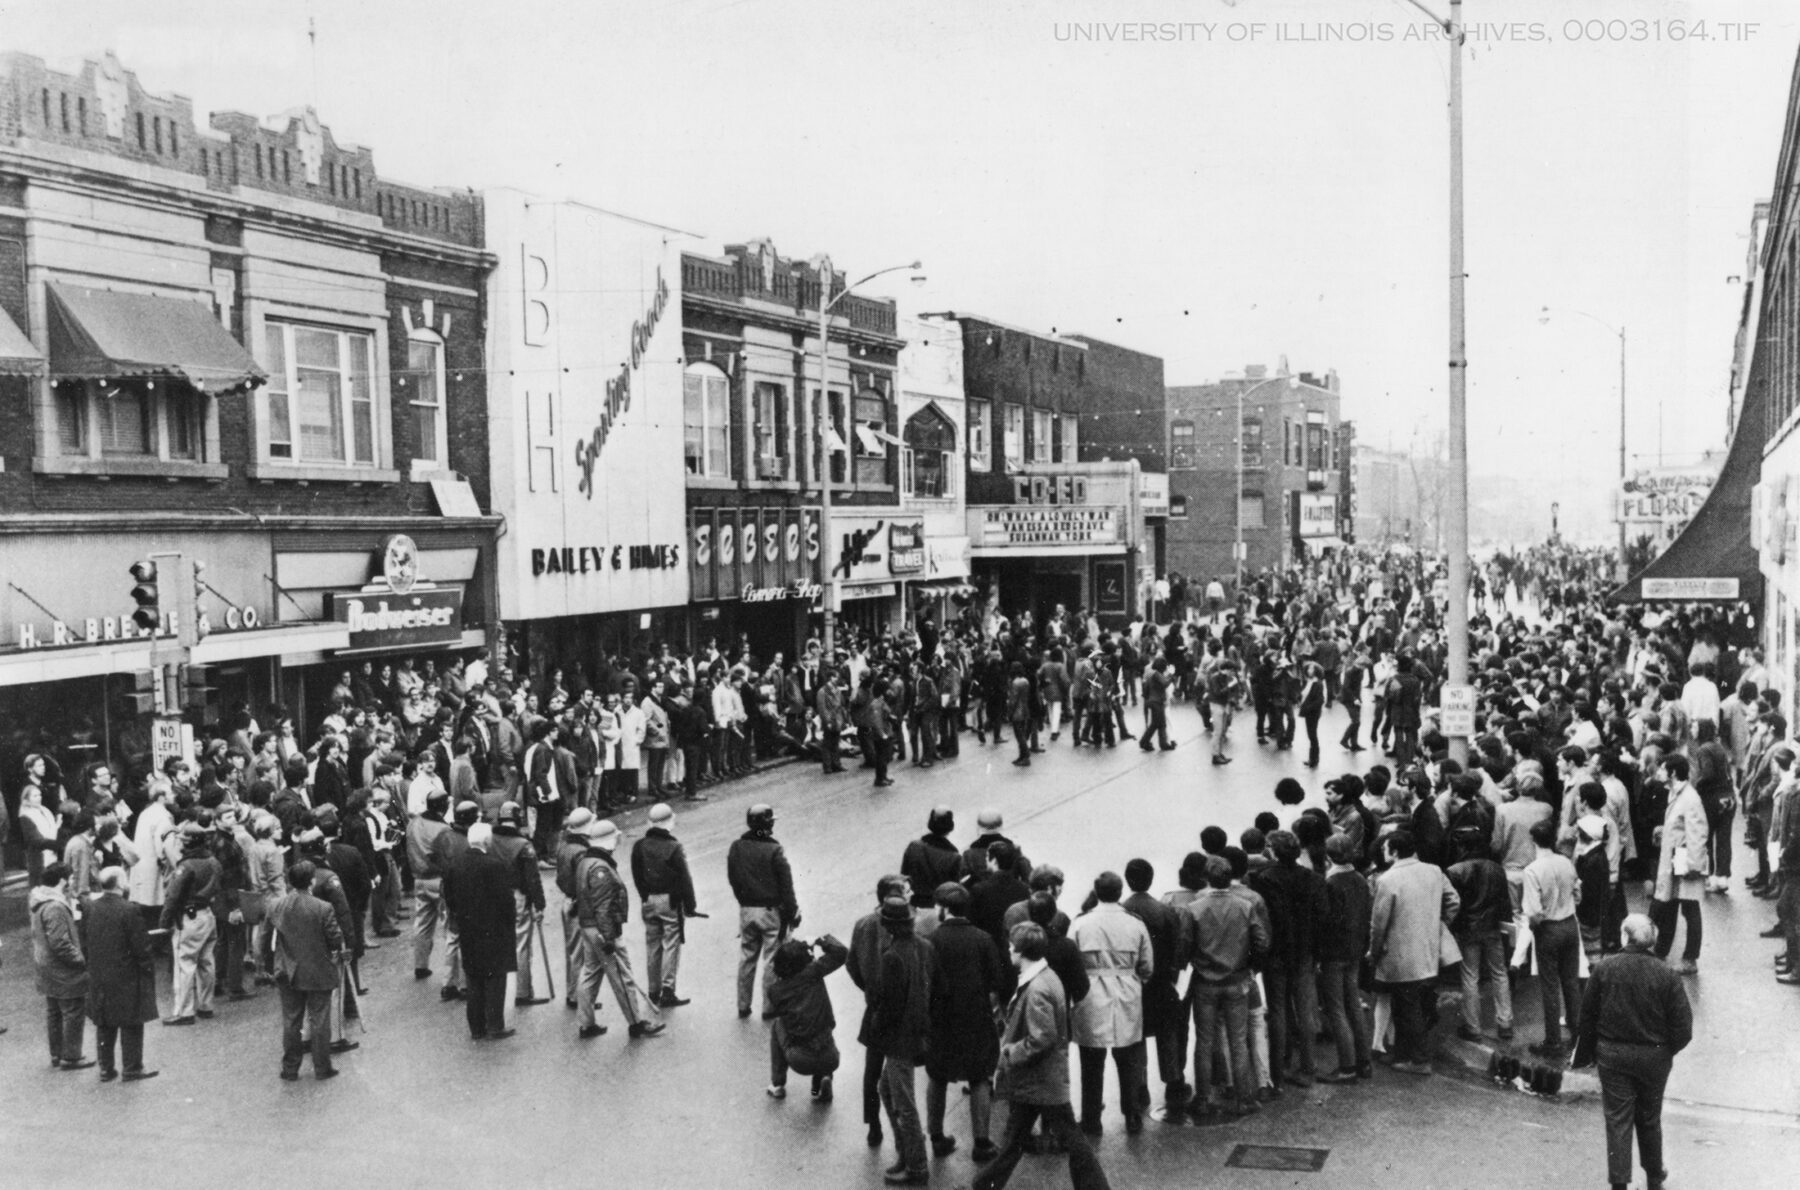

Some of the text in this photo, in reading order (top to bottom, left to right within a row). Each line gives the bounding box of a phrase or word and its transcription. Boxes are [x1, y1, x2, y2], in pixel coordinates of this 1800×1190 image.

[575, 265, 669, 500] Sporting Goods
[1014, 475, 1087, 505] CO-ED
[1006, 512, 1035, 522] WHAT
[1040, 512, 1046, 522] A
[1049, 511, 1085, 521] LOVELY
[1089, 511, 1109, 521] WAR
[1004, 521, 1104, 532] VANESSA REDGRAVE
[1010, 531, 1091, 543] SUSANNAH YORK
[531, 544, 680, 577] BAILEY & HIMES
[792, 578, 823, 603] Shop
[20, 624, 42, 649] H.
[53, 620, 75, 645] R.
[85, 611, 178, 641] BREE
[225, 605, 263, 631] CO.
[1450, 690, 1463, 700] NO
[160, 726, 175, 738] NO
[158, 741, 178, 752] LEFT
